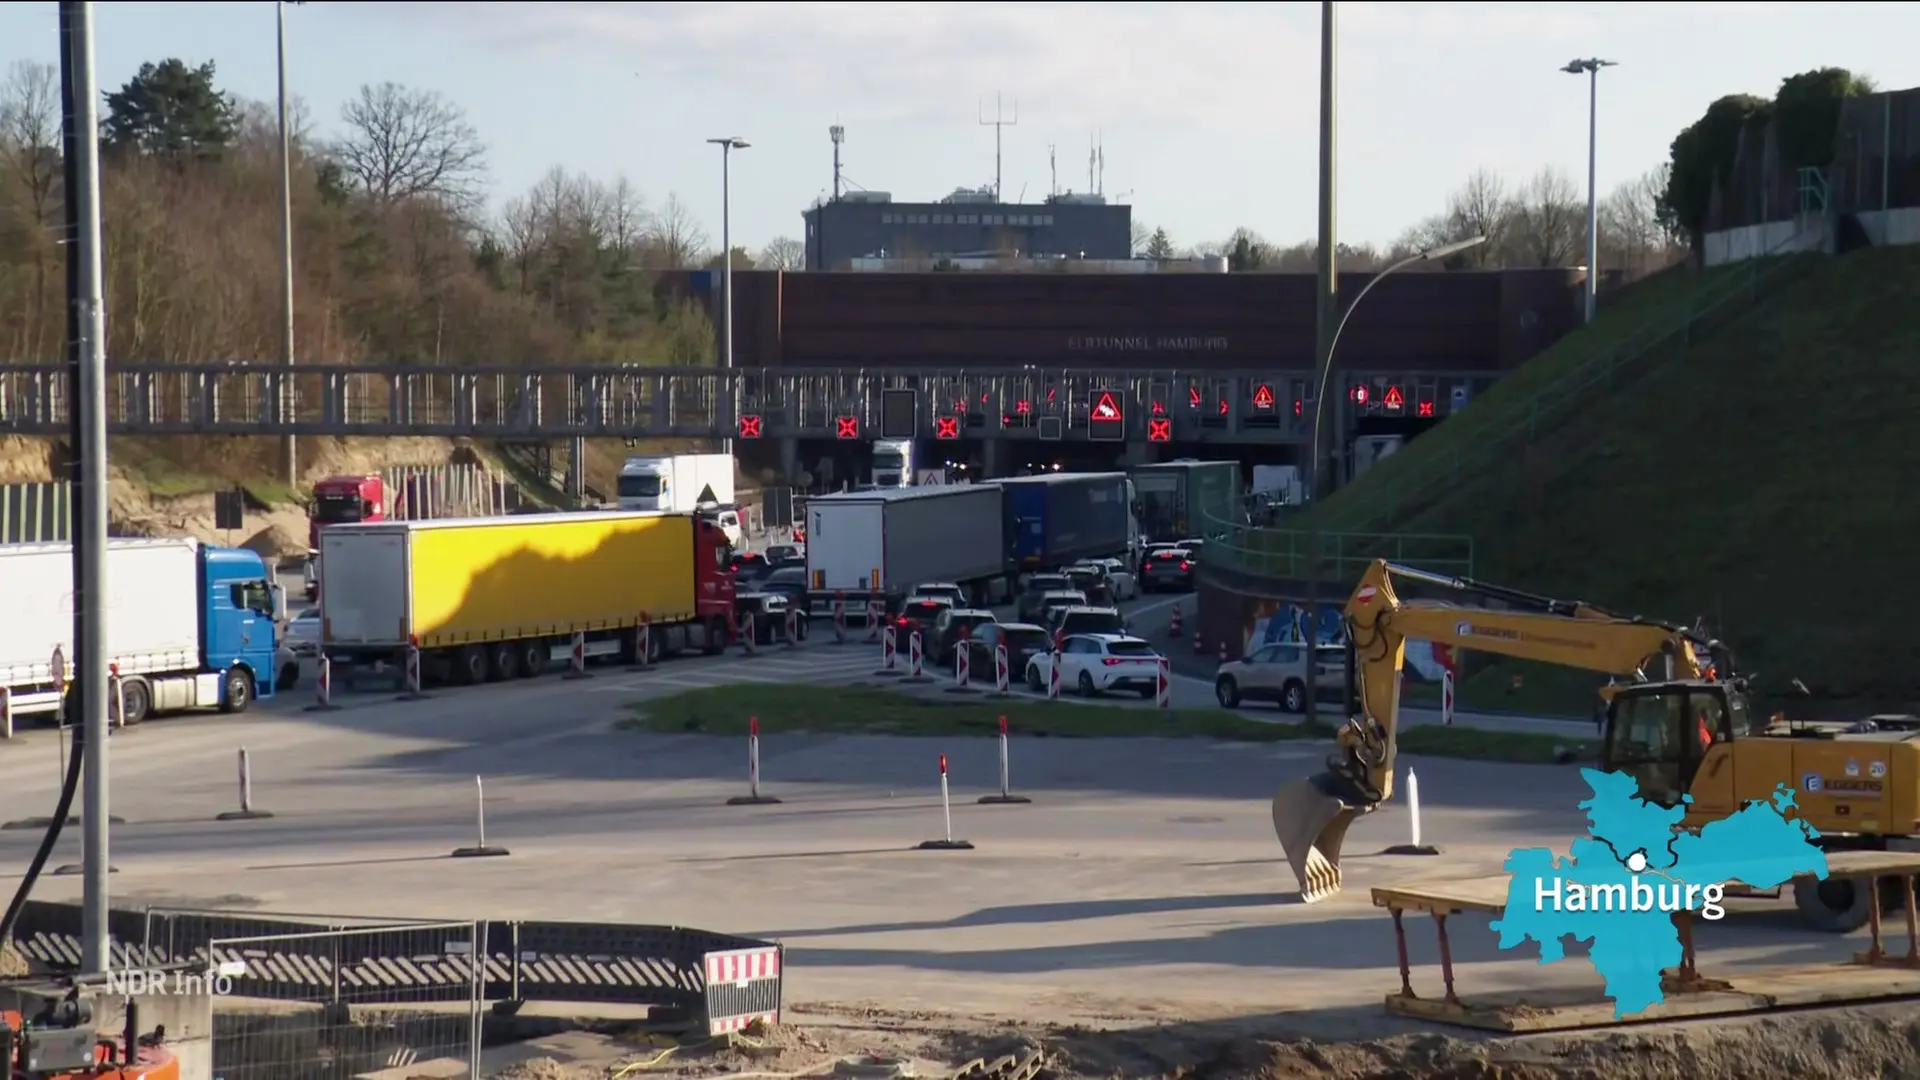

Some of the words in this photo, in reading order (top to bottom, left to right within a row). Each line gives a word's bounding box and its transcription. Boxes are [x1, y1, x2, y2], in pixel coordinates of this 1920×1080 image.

[1068, 336, 1151, 350] ELBTUNNEL
[1157, 336, 1229, 350] HAMBURG
[1824, 779, 1883, 792] EGGERS
